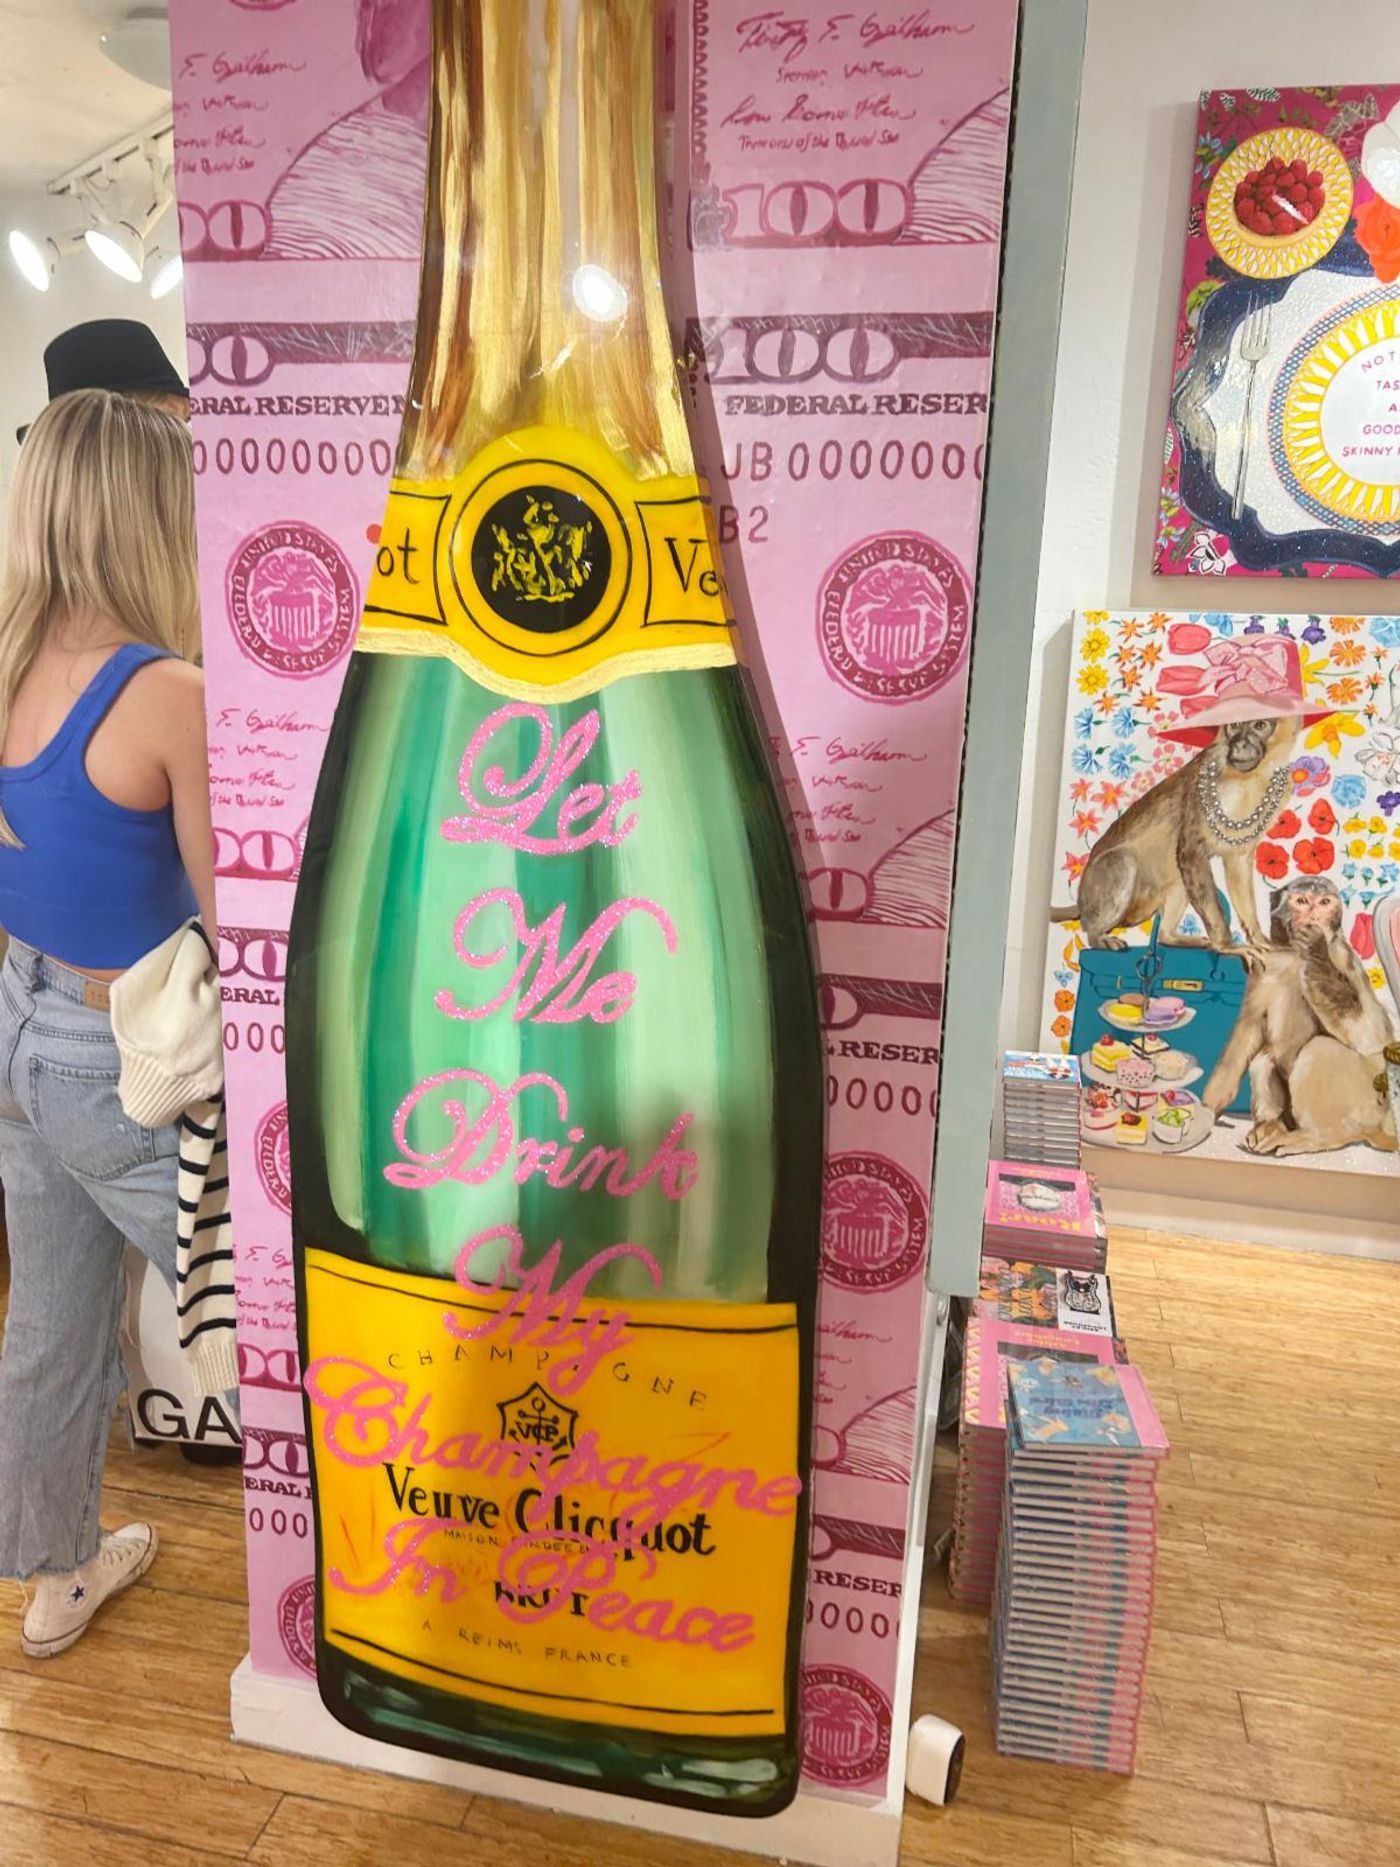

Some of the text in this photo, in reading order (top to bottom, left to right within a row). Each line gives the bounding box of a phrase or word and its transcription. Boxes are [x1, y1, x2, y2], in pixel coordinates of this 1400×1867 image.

[725, 393, 868, 417] FEDERAL
[1388, 403, 1400, 412] A
[1342, 446, 1393, 457] SKINNY
[440, 702, 641, 856] Let
[434, 887, 677, 1024] Me
[383, 1067, 698, 1200] Drink
[442, 1222, 663, 1396] My
[137, 1388, 242, 1444] GA
[249, 1507, 308, 1538] 000
[382, 1462, 500, 1530] Veuve
[545, 1646, 632, 1668] FRANCE
